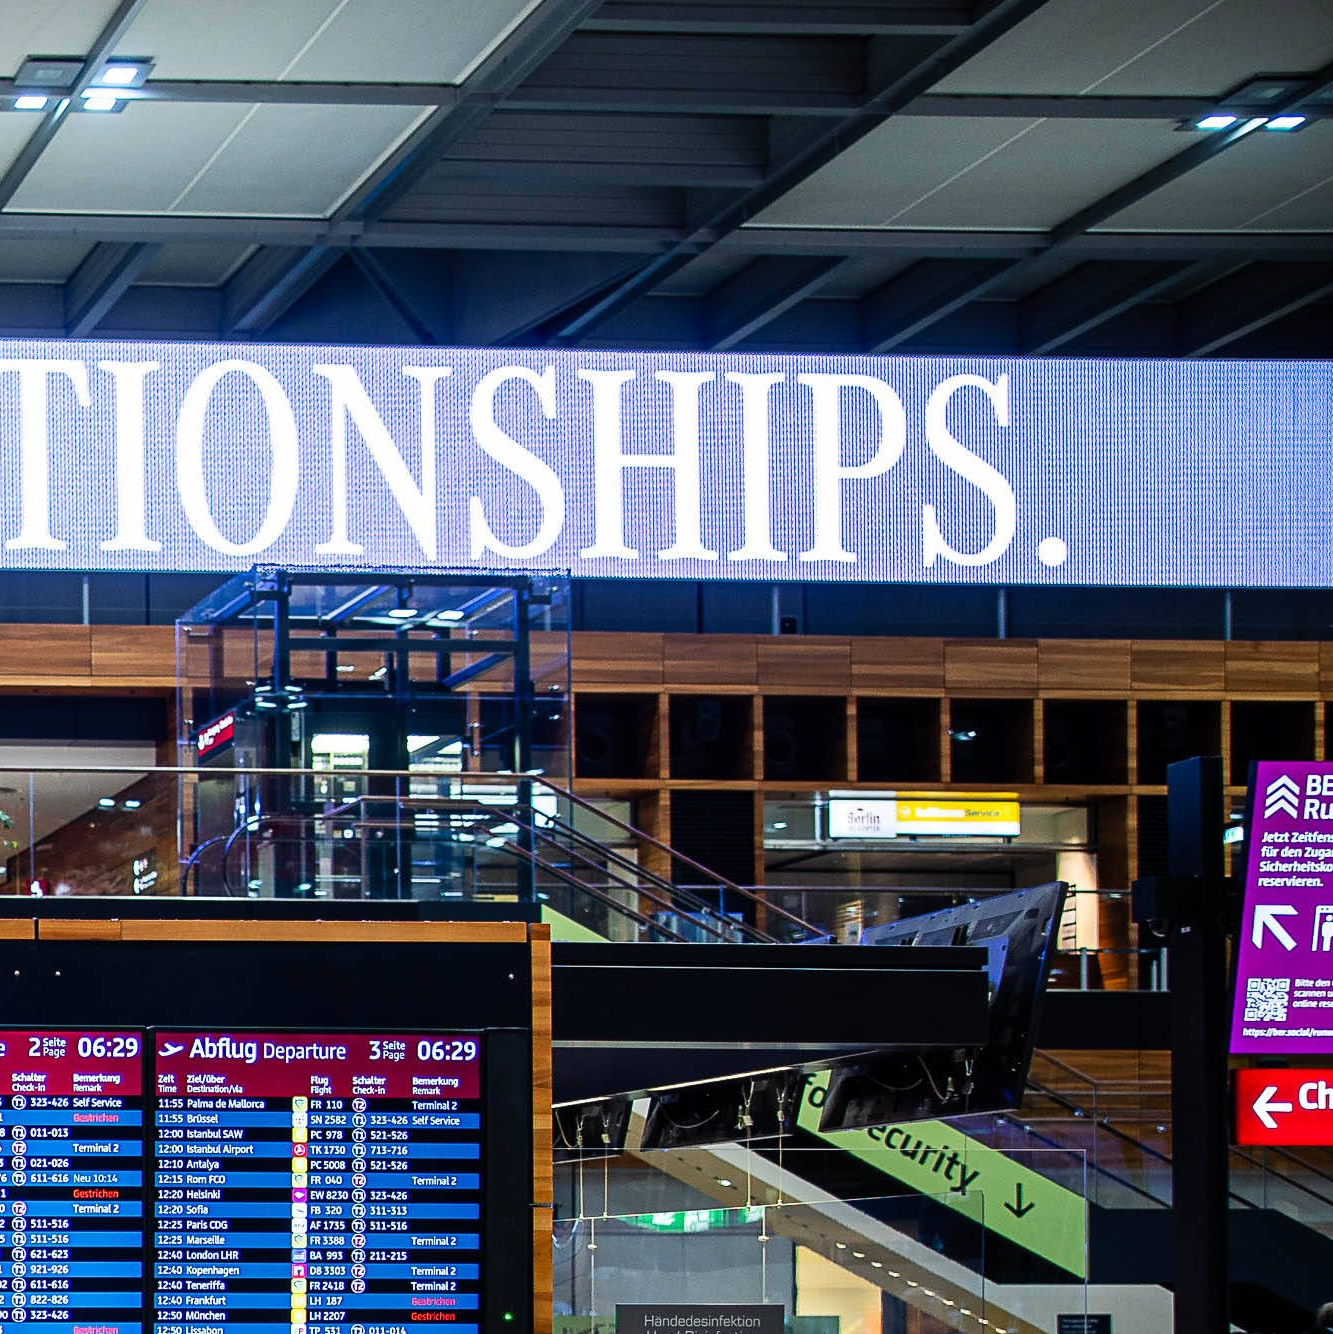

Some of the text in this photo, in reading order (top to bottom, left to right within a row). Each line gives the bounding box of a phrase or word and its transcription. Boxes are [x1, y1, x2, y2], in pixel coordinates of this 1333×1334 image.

[1262, 832, 1289, 843] Jetzt
[1261, 847, 1278, 857] für
[1281, 847, 1302, 857] den
[1258, 877, 1324, 887] reservieren.
[29, 1038, 40, 1056] 2
[43, 1037, 66, 1049] Seite
[78, 1038, 138, 1057] 06:29
[383, 1041, 405, 1050] Seite
[43, 1047, 65, 1058] Page
[189, 1037, 346, 1063] Abflug Departure
[370, 1041, 380, 1059] 3
[418, 1041, 475, 1060] 06:29
[383, 1051, 404, 1061] Page
[30, 1159, 69, 1167] 021-026
[645, 1315, 761, 1328] Händedesinfektion
